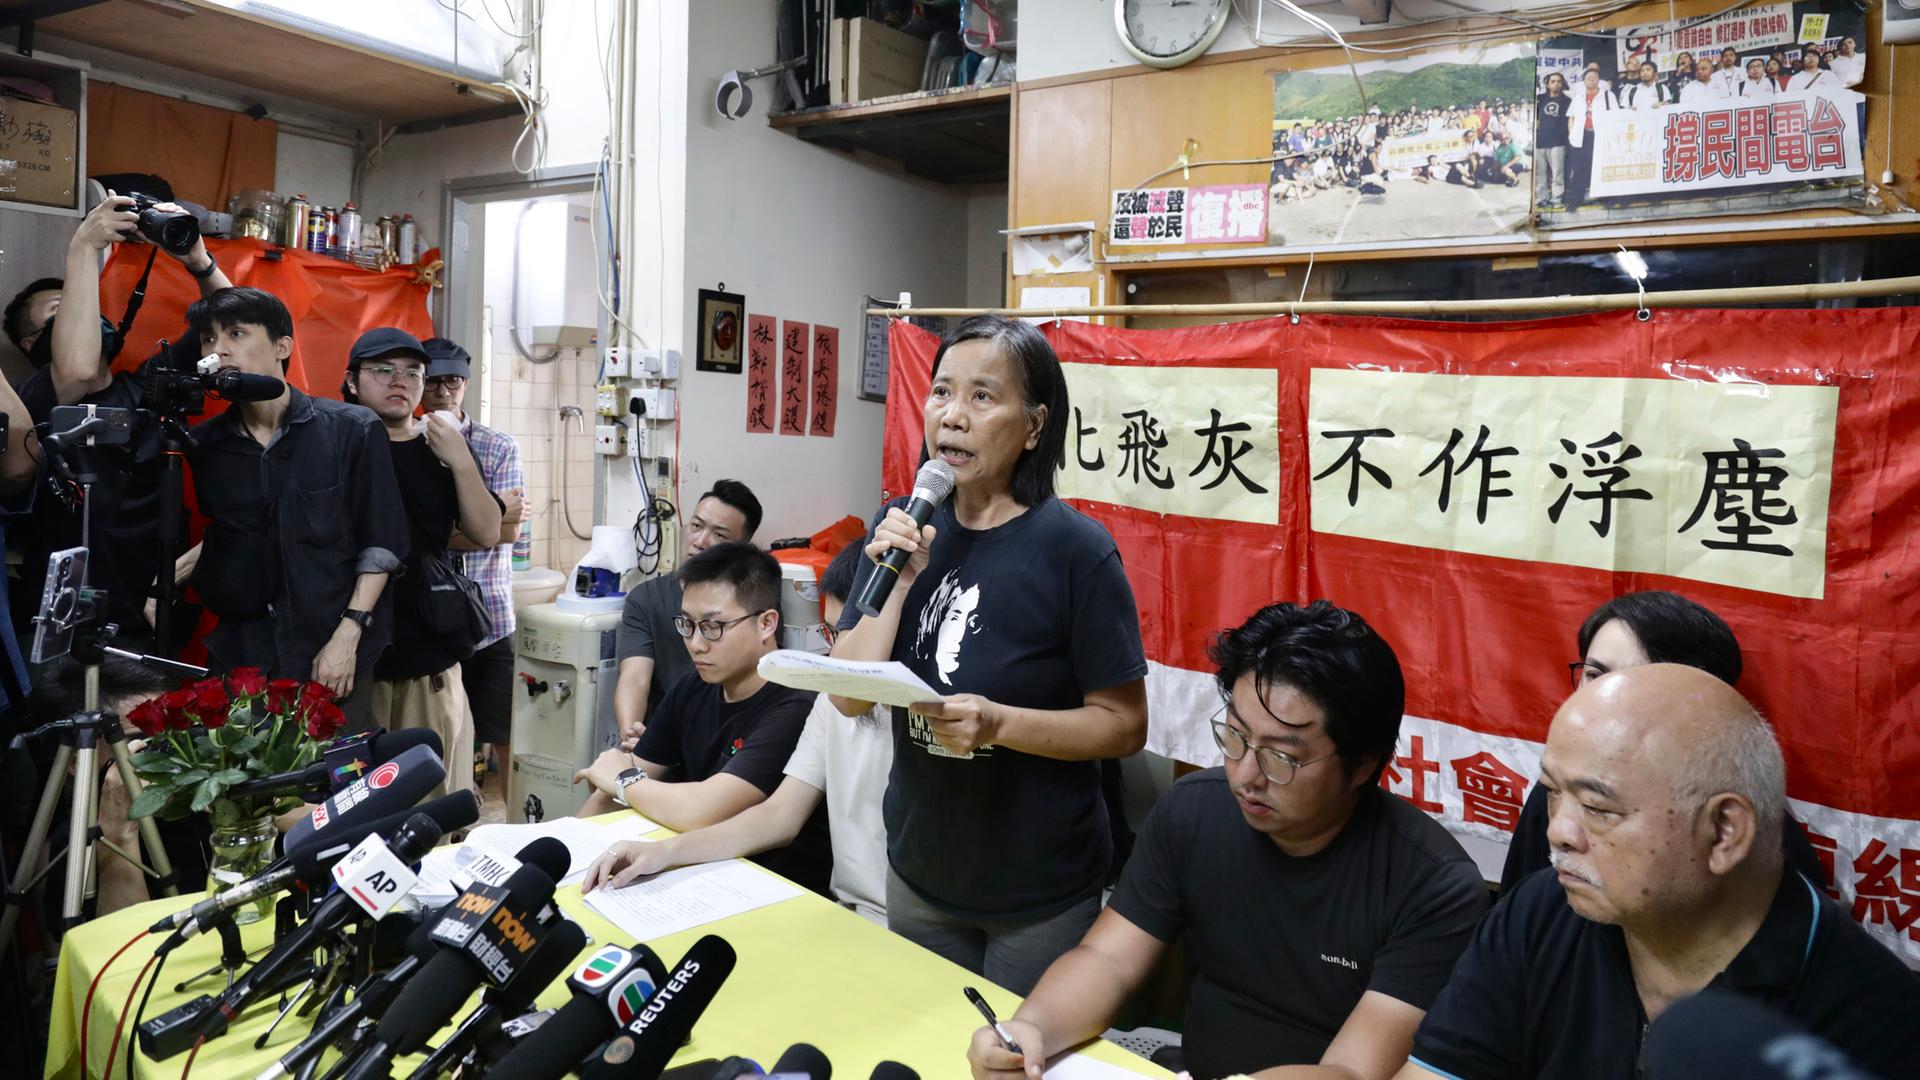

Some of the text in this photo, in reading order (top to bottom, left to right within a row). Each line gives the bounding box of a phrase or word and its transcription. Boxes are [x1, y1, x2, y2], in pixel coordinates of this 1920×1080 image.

[1669, 25, 1712, 50] 衛言論自由
[1190, 188, 1265, 240] 復播
[1243, 202, 1260, 210] dbc
[1114, 215, 1183, 240] 還聲於民
[1313, 424, 1799, 557] 不作浮塵
[364, 870, 398, 894] AP
[471, 855, 511, 886] TMHK
[456, 892, 497, 916] now
[491, 906, 537, 953] now
[468, 931, 514, 984] 財經台
[629, 958, 701, 1036] REUTERS
